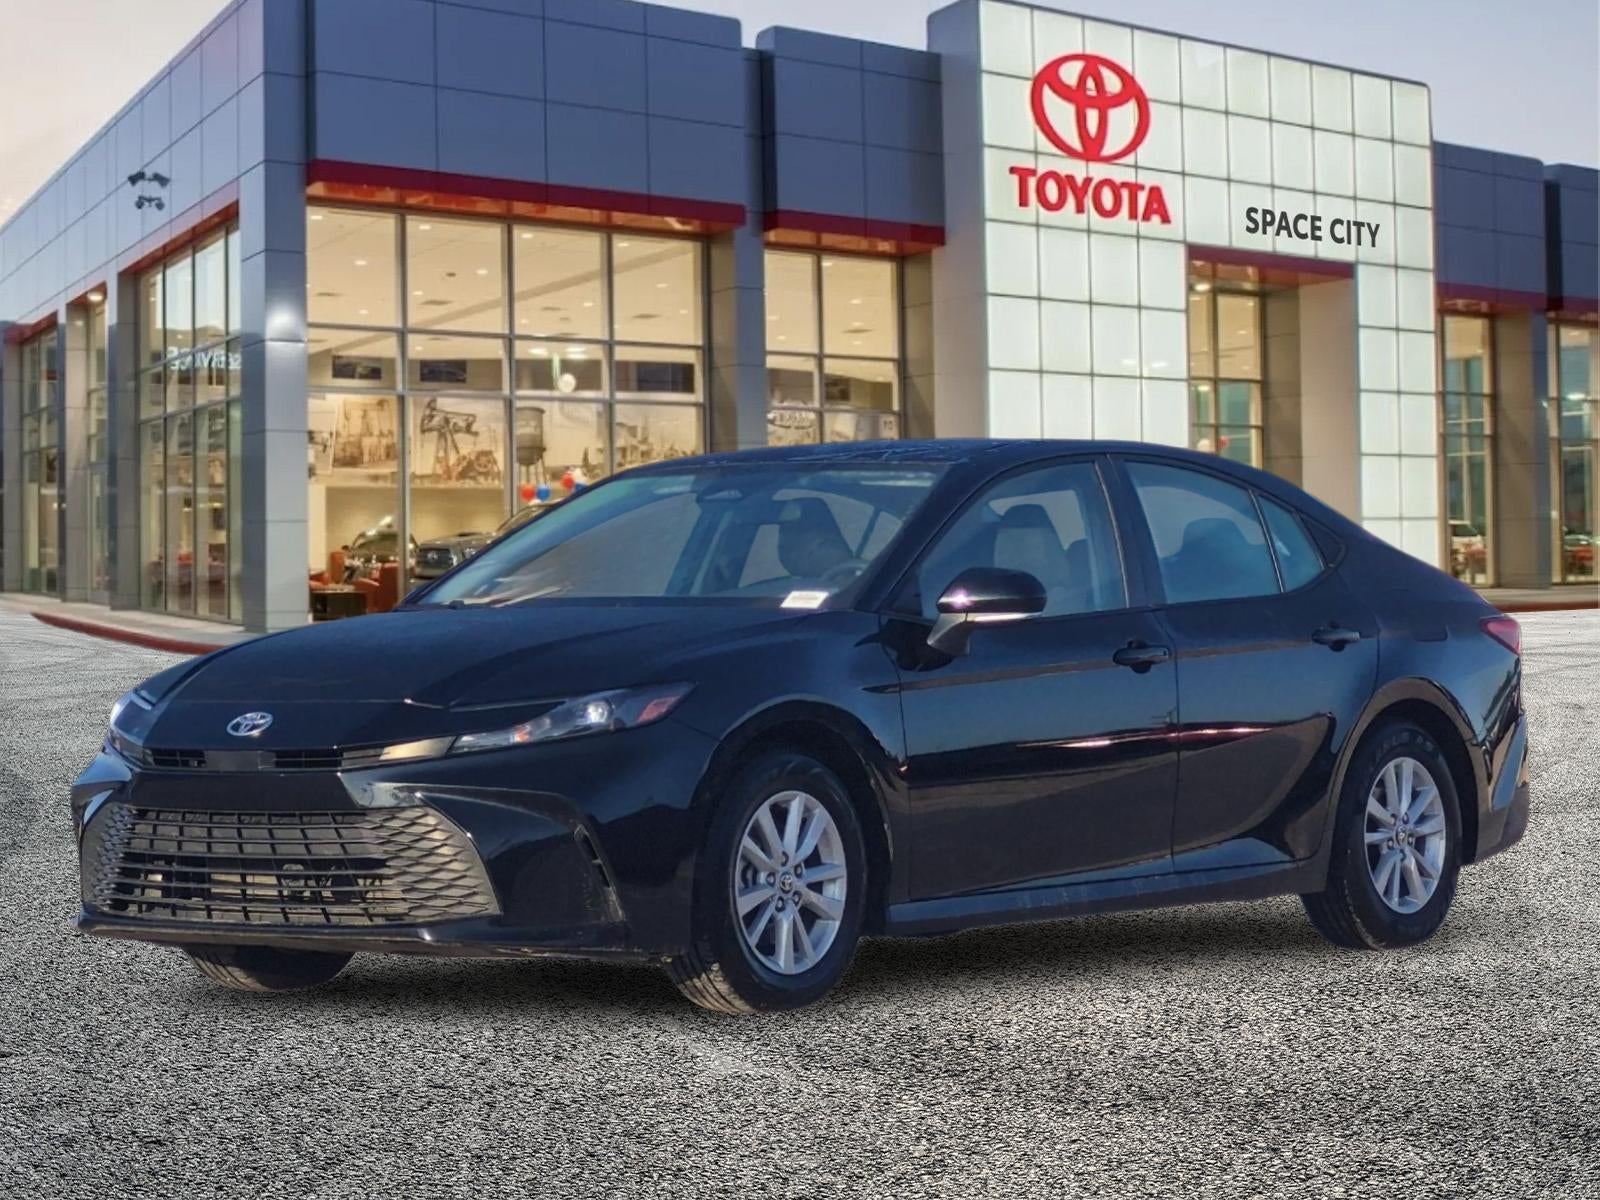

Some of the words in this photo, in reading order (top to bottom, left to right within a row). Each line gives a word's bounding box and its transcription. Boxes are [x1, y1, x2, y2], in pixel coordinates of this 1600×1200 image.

[1009, 166, 1171, 224] TOYOTA
[1245, 207, 1322, 242] SPACE
[1329, 218, 1380, 248] CITY
